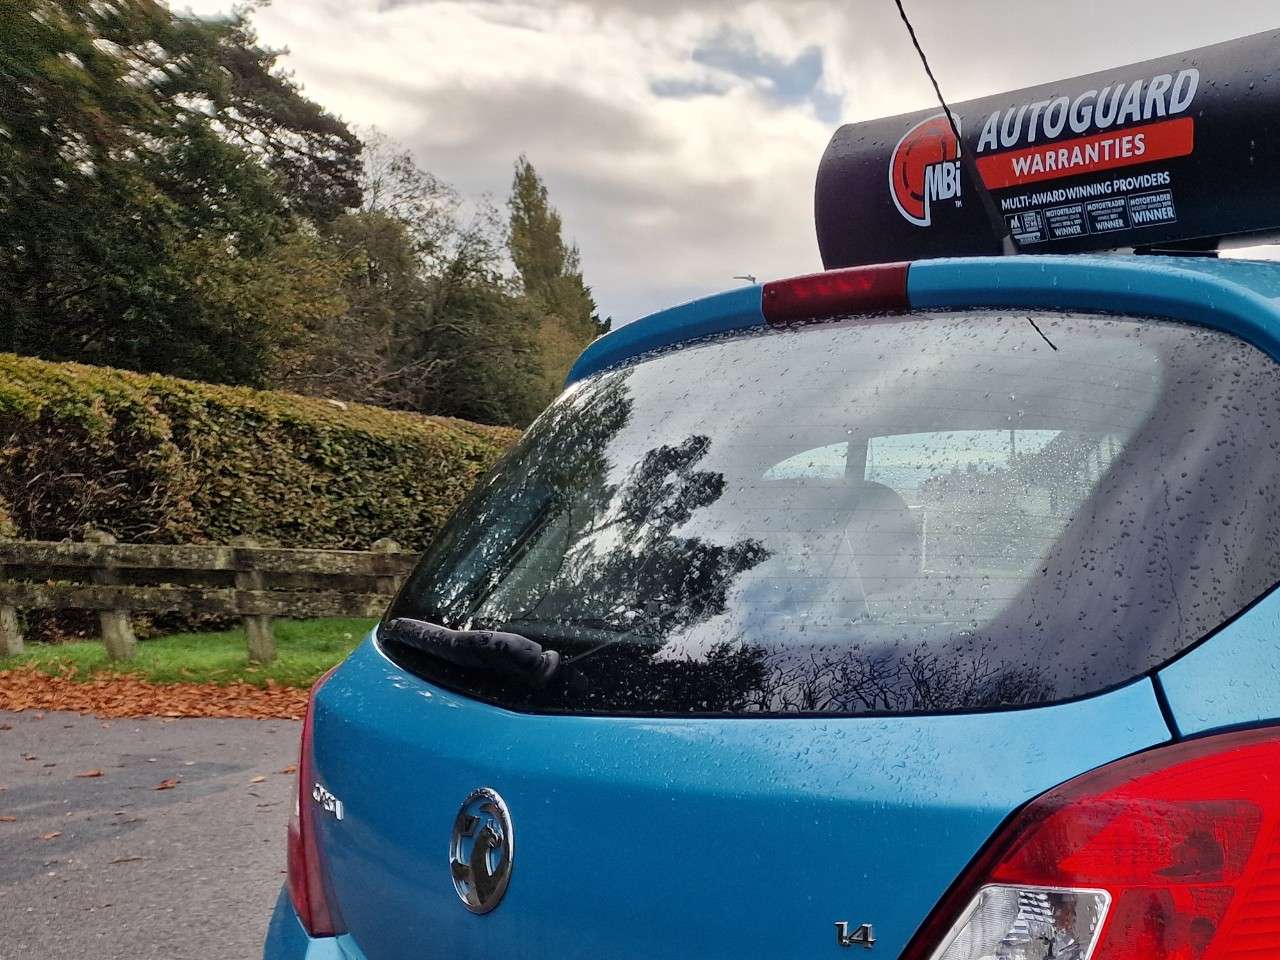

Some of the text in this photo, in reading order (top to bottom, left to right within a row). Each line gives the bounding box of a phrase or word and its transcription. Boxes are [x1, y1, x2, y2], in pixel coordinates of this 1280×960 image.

[976, 68, 1200, 153] AUTOGUARD
[1011, 133, 1146, 177] WARRANTIES
[925, 160, 961, 202] MBi
[1001, 171, 1171, 212] MULTI-AWARD WINNING PROVIDERS
[1053, 224, 1082, 237] WINNER
[1095, 218, 1125, 231] WINNER
[1131, 207, 1175, 223] WINNER
